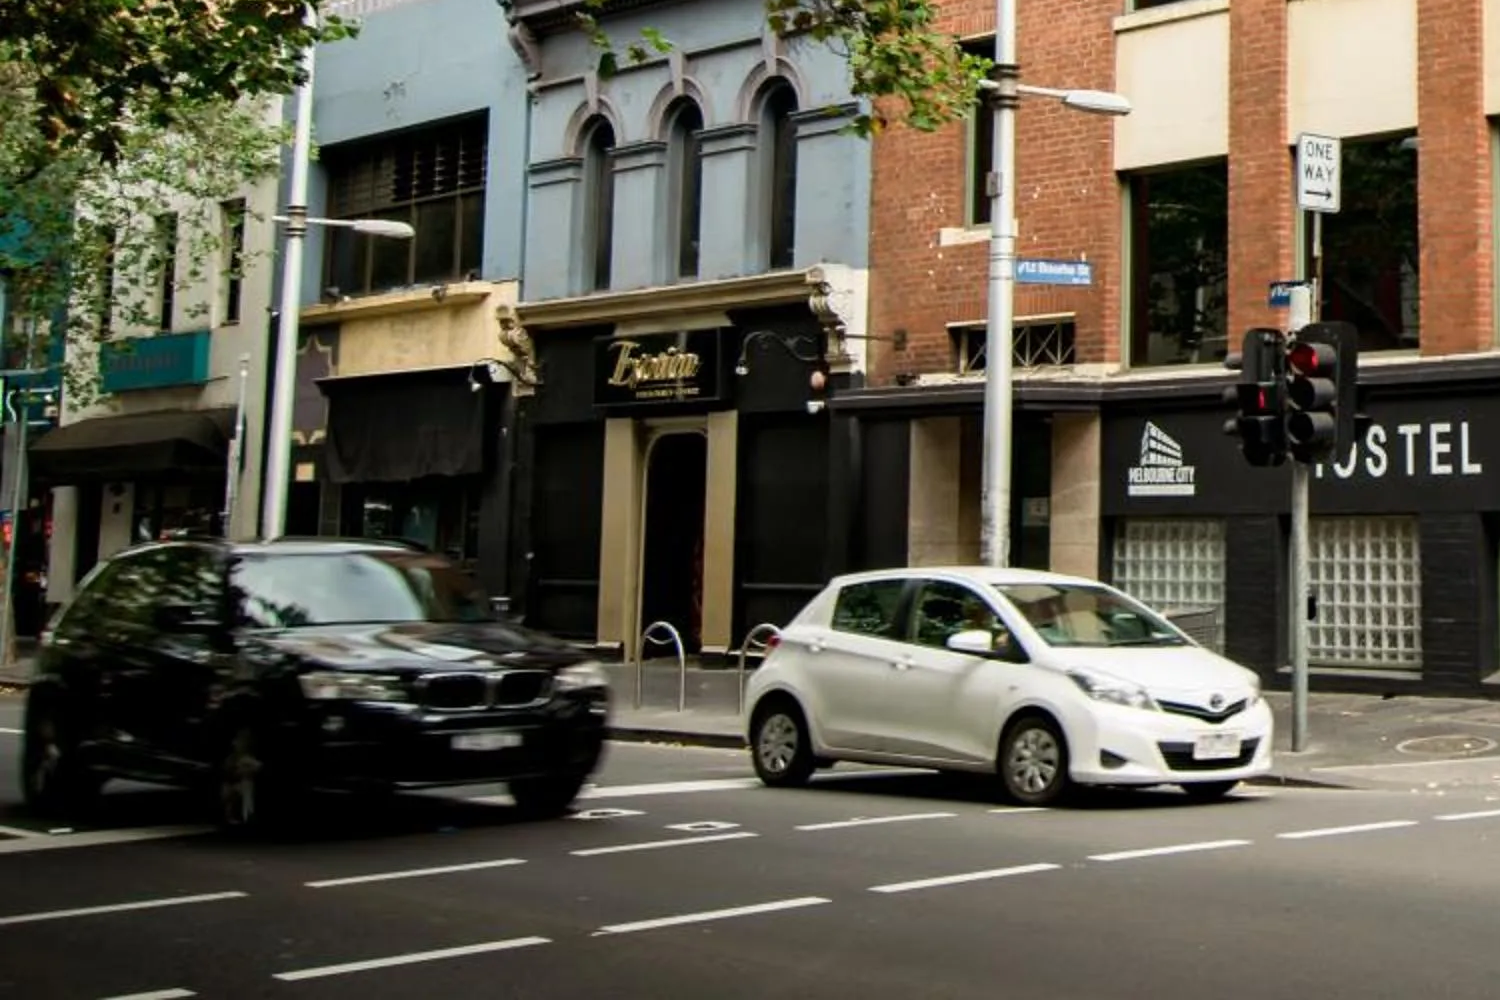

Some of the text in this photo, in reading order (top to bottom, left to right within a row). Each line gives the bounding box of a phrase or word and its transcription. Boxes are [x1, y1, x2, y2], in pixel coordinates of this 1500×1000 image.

[1305, 141, 1333, 160] ONE
[1304, 164, 1335, 183] WAY
[1316, 421, 1482, 478] STEL
[1128, 466, 1194, 483] MELBOURNE CITY
